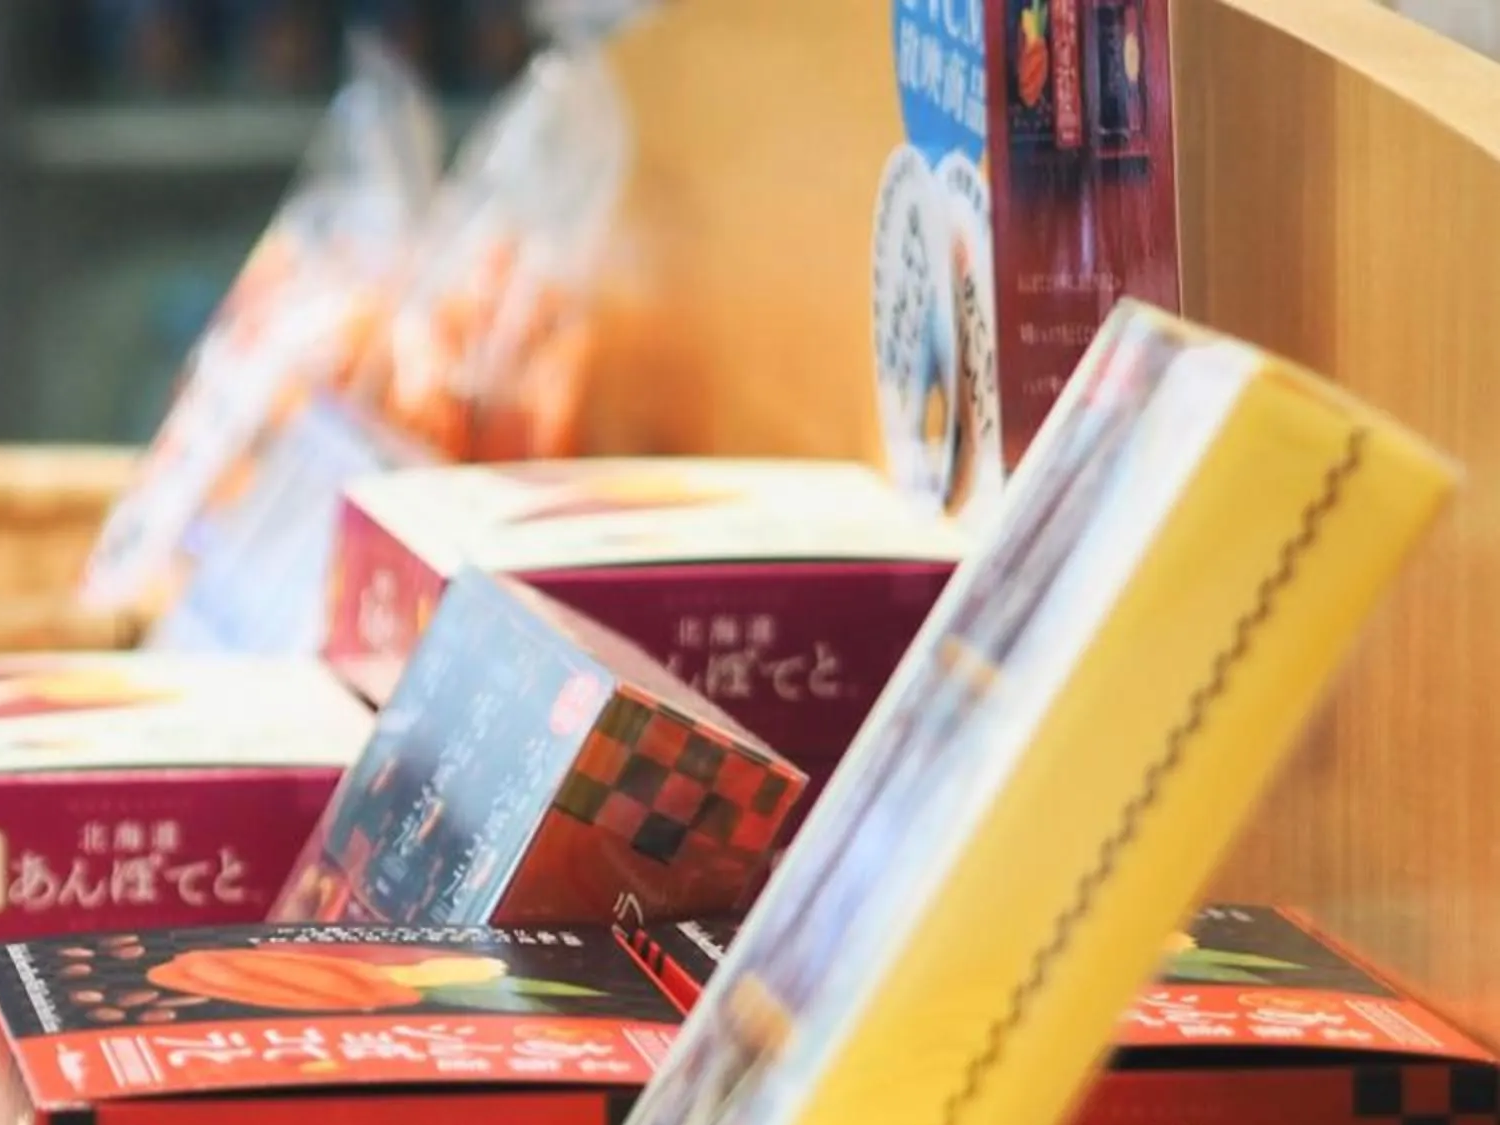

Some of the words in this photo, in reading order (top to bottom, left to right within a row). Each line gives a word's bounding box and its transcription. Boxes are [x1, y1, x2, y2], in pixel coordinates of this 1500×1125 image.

[8, 849, 248, 913] あんぽてと
